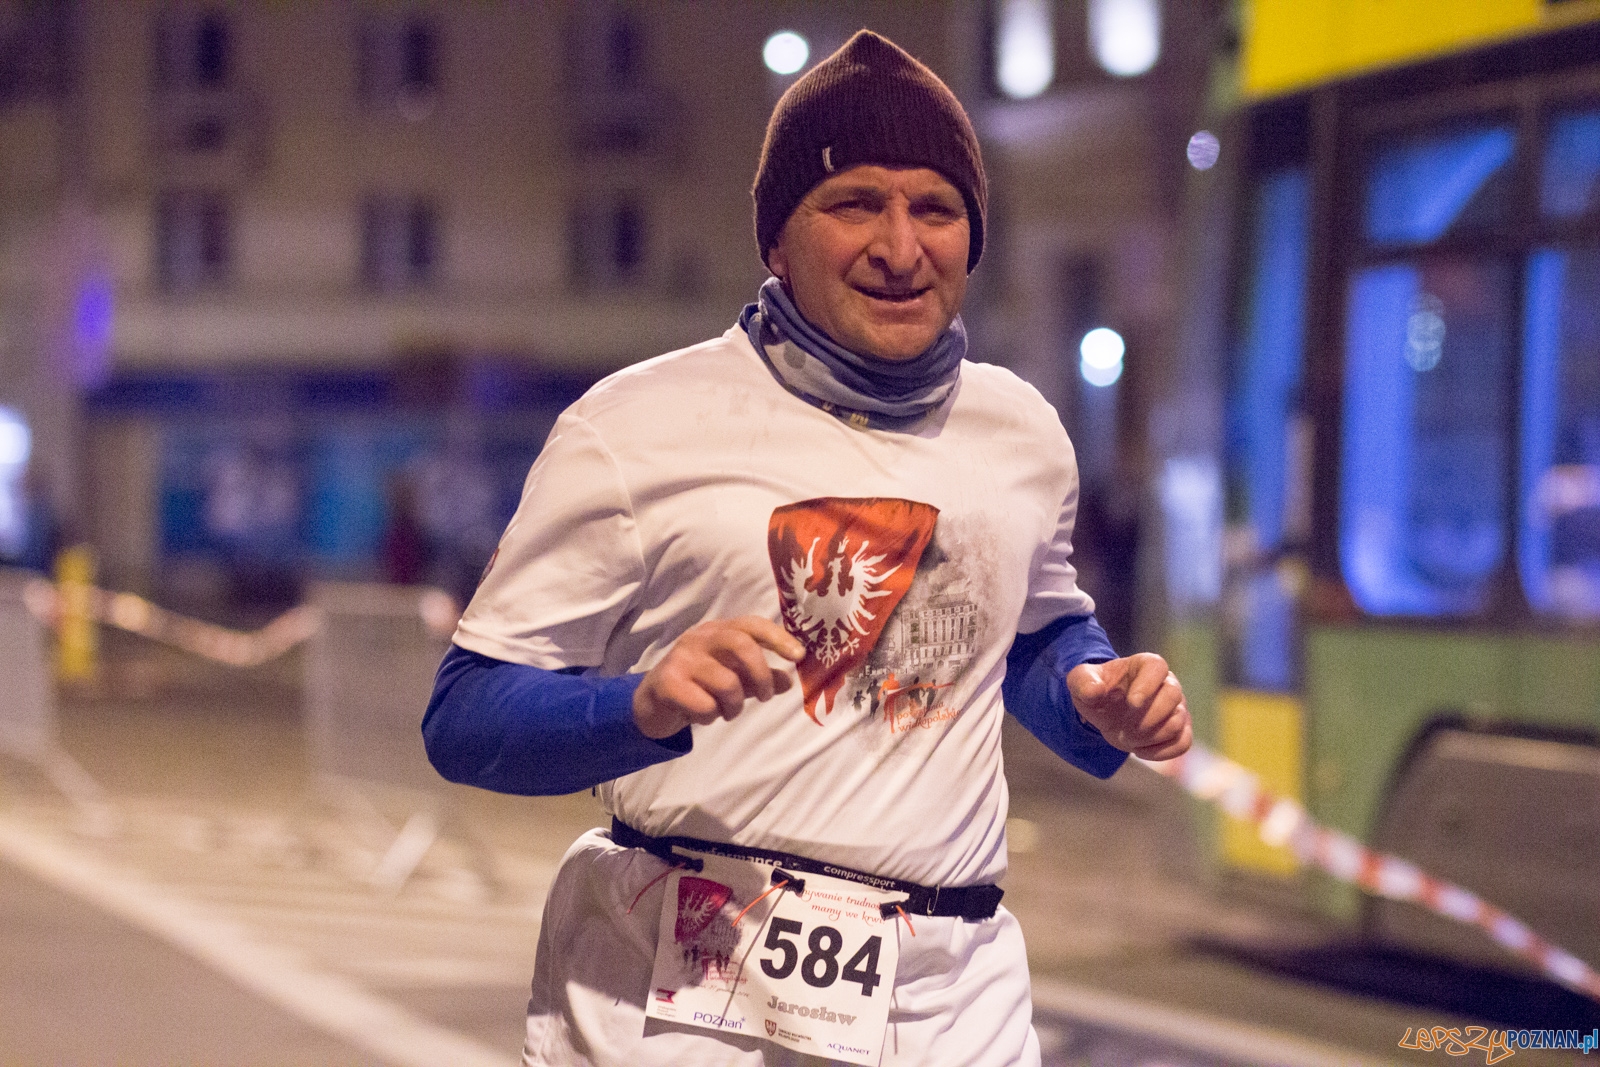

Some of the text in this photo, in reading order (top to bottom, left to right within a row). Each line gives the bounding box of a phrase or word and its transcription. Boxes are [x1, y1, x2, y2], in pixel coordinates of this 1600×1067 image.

[824, 865, 896, 888] compressport
[811, 904, 841, 921] mamy
[845, 910, 858, 918] we
[760, 916, 883, 997] 584
[767, 995, 857, 1026] Jarosław
